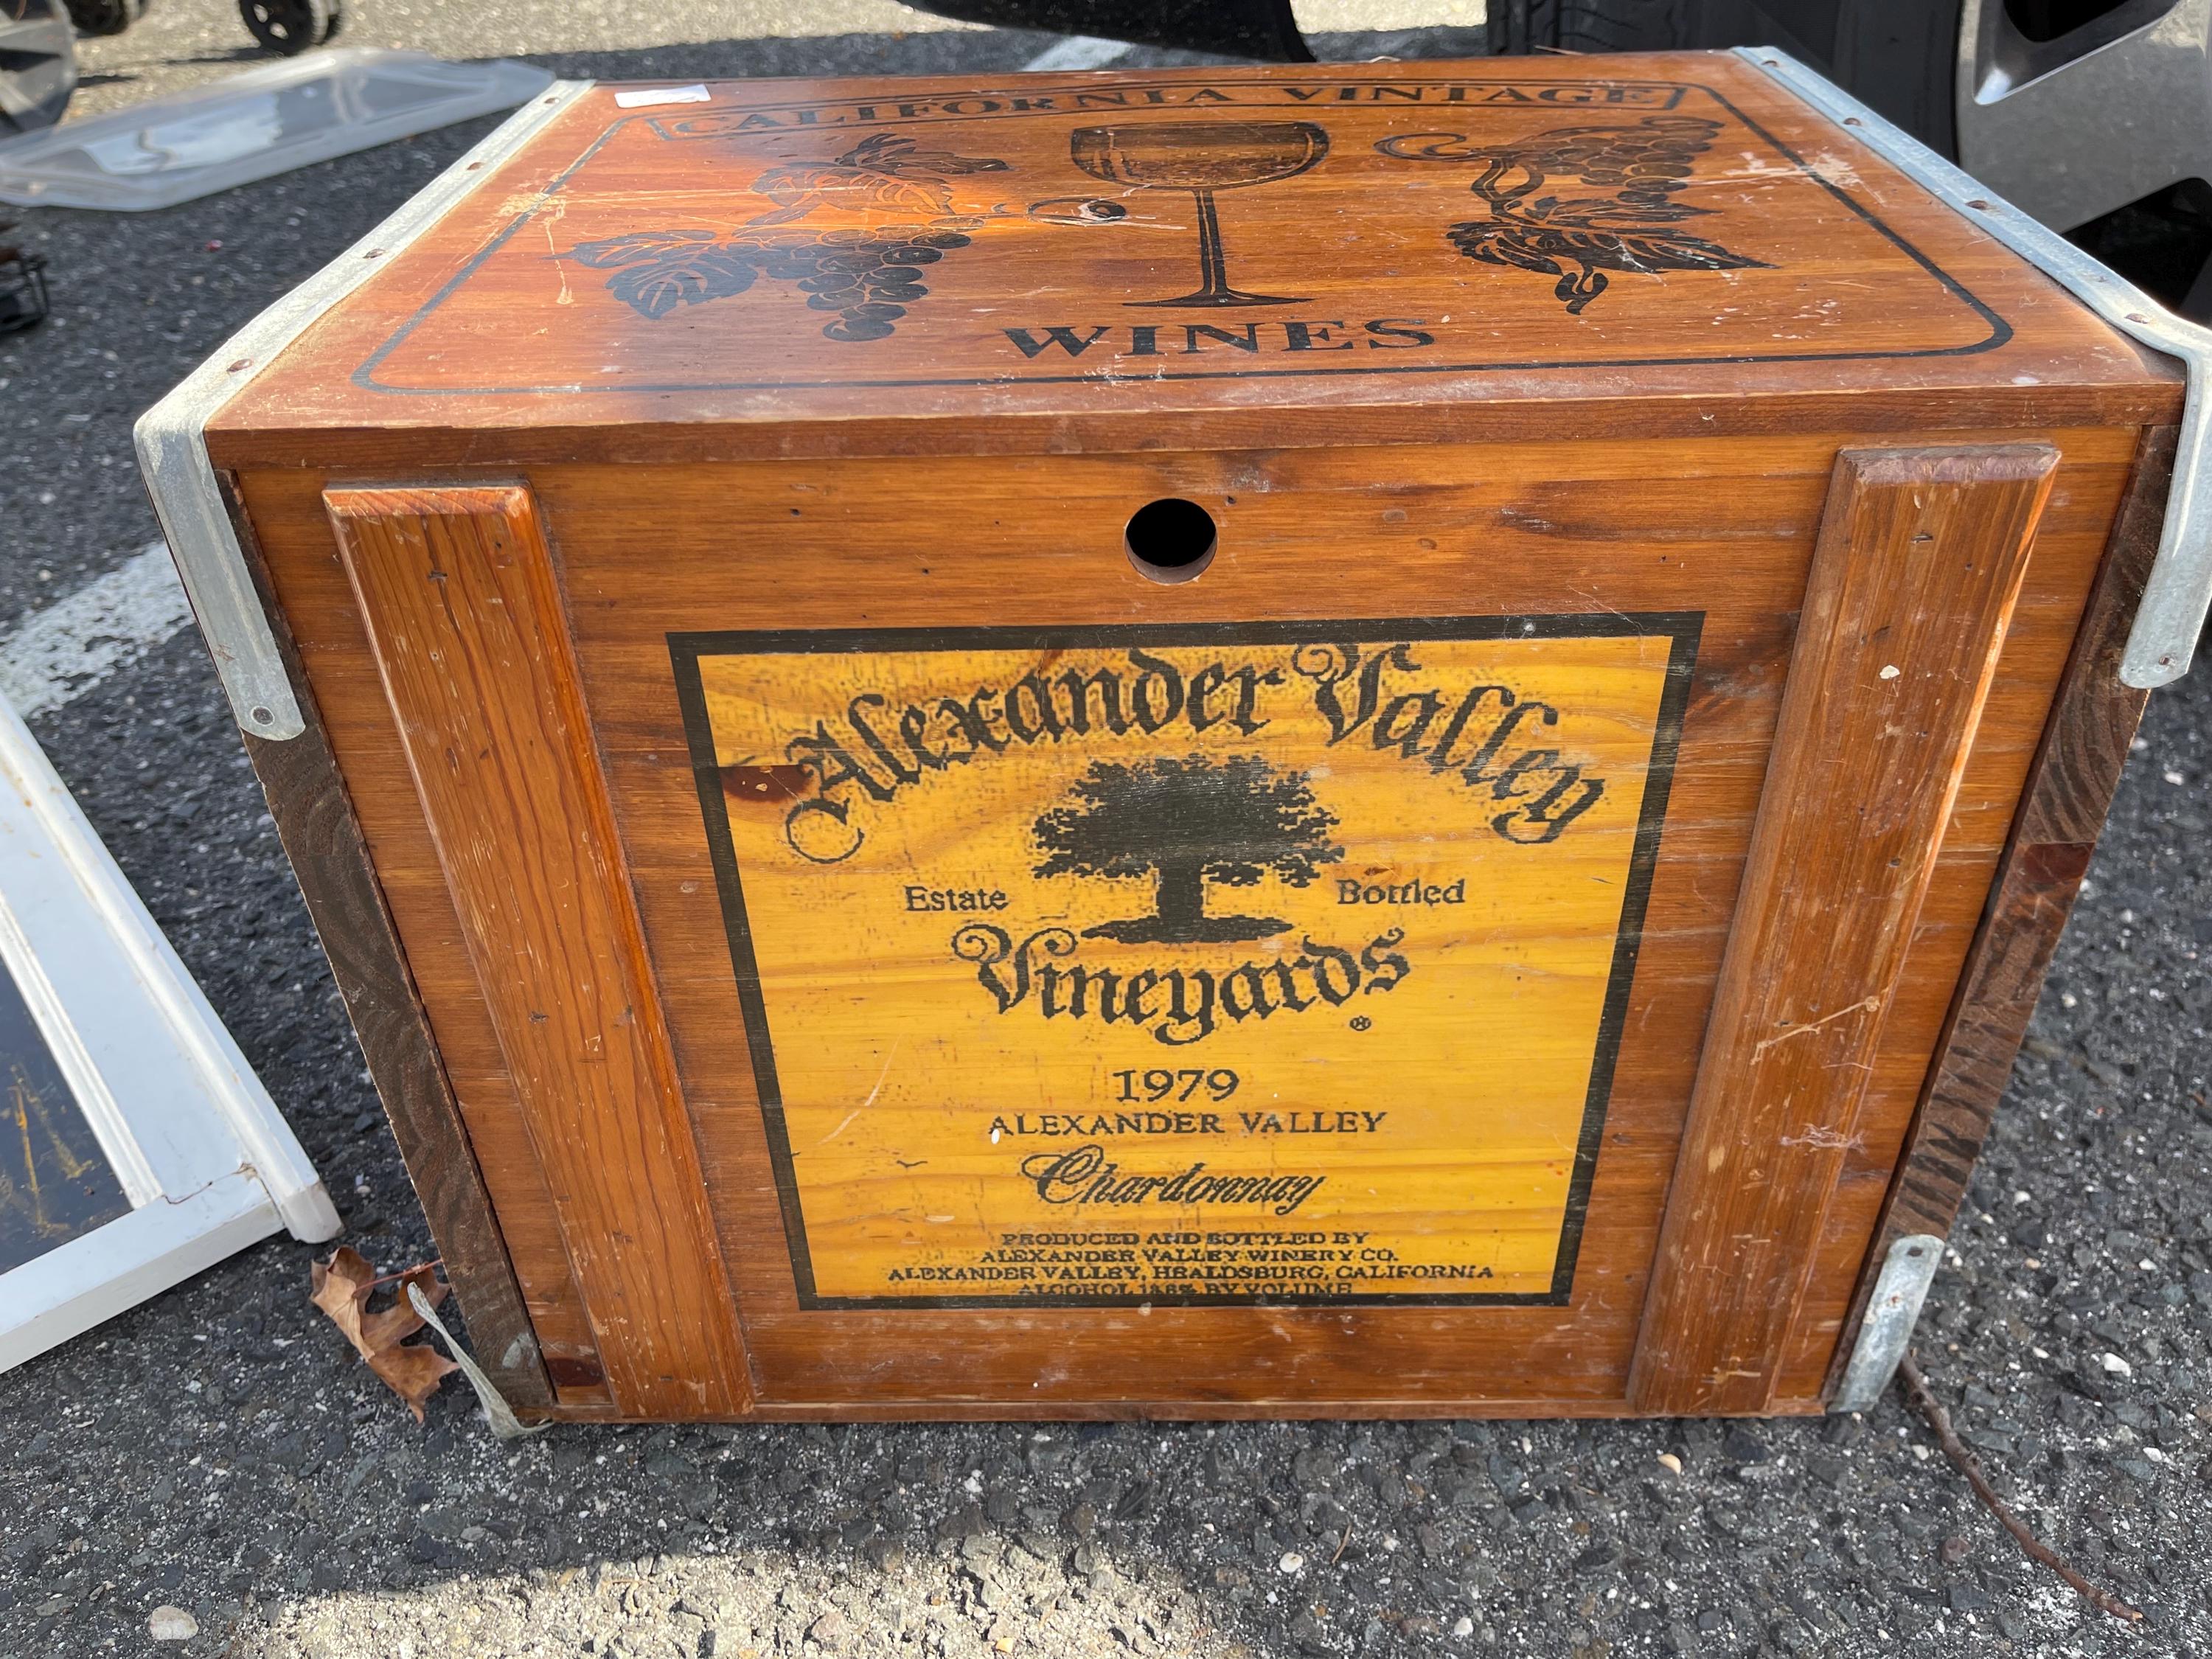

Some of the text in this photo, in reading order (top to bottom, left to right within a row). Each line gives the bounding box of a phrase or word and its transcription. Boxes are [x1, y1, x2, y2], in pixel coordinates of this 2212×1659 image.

[672, 86, 1659, 134] CALIFORNIA VINTAGE
[1002, 317, 1435, 359] WINES
[785, 643, 1606, 863] Alexander Valley
[905, 878, 1465, 911] Estate Bottled
[951, 924, 1411, 1046] Vineyards
[1113, 1069, 1240, 1102] 1979
[989, 1111, 1387, 1136] ALEXANDER VALLEY
[1021, 1144, 1326, 1216] Chardonnay
[1001, 1232, 1369, 1246] PRODUCED AND BOTTLED BY
[981, 1250, 1135, 1263] ALEXANDER
[1142, 1249, 1240, 1262] VALLEY
[1247, 1249, 1354, 1262] WINERY
[888, 1266, 1037, 1281] ALEXANDER
[1335, 1265, 1494, 1280] CALIFORNIA
